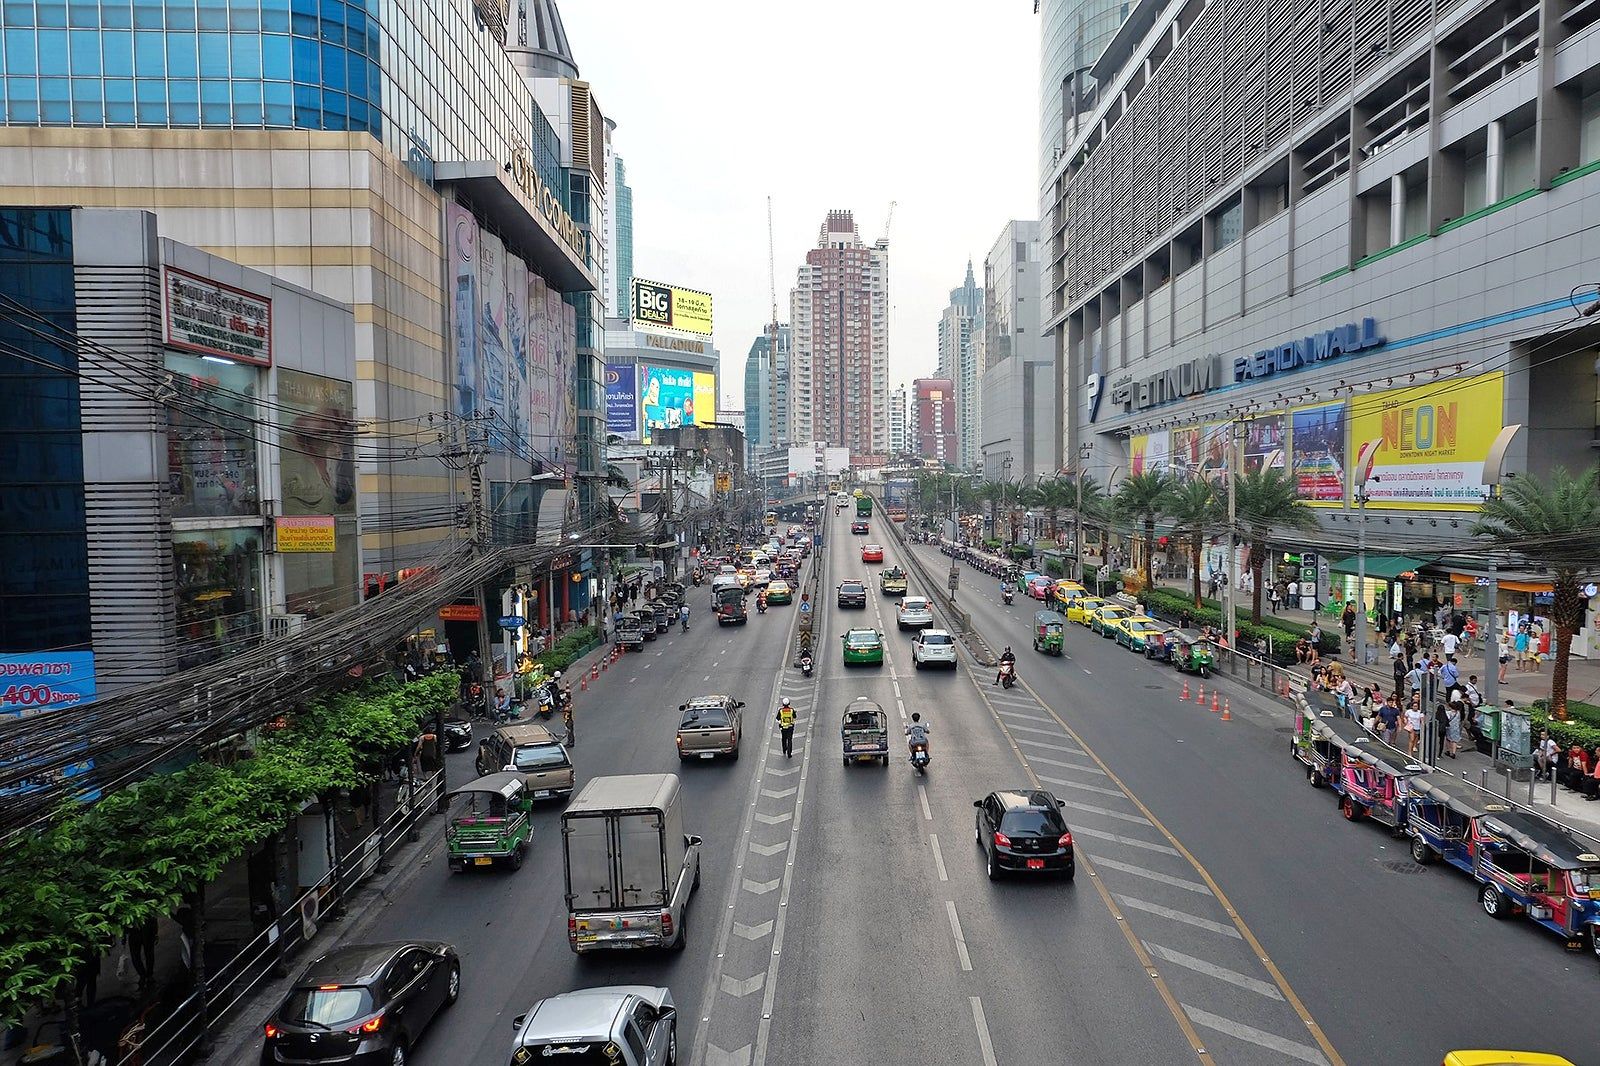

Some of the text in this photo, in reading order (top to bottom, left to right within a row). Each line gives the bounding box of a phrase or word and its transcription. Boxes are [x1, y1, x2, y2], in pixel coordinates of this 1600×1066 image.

[512, 147, 587, 264] CITY COMPLEX
[640, 308, 669, 322] DEALS!
[646, 334, 705, 353] PALLADIUM
[1233, 316, 1388, 383] FASHION MALL
[1381, 402, 1458, 452] NEON
[1438, 449, 1456, 457] MARKET
[3, 685, 80, 705] 400 Shops
